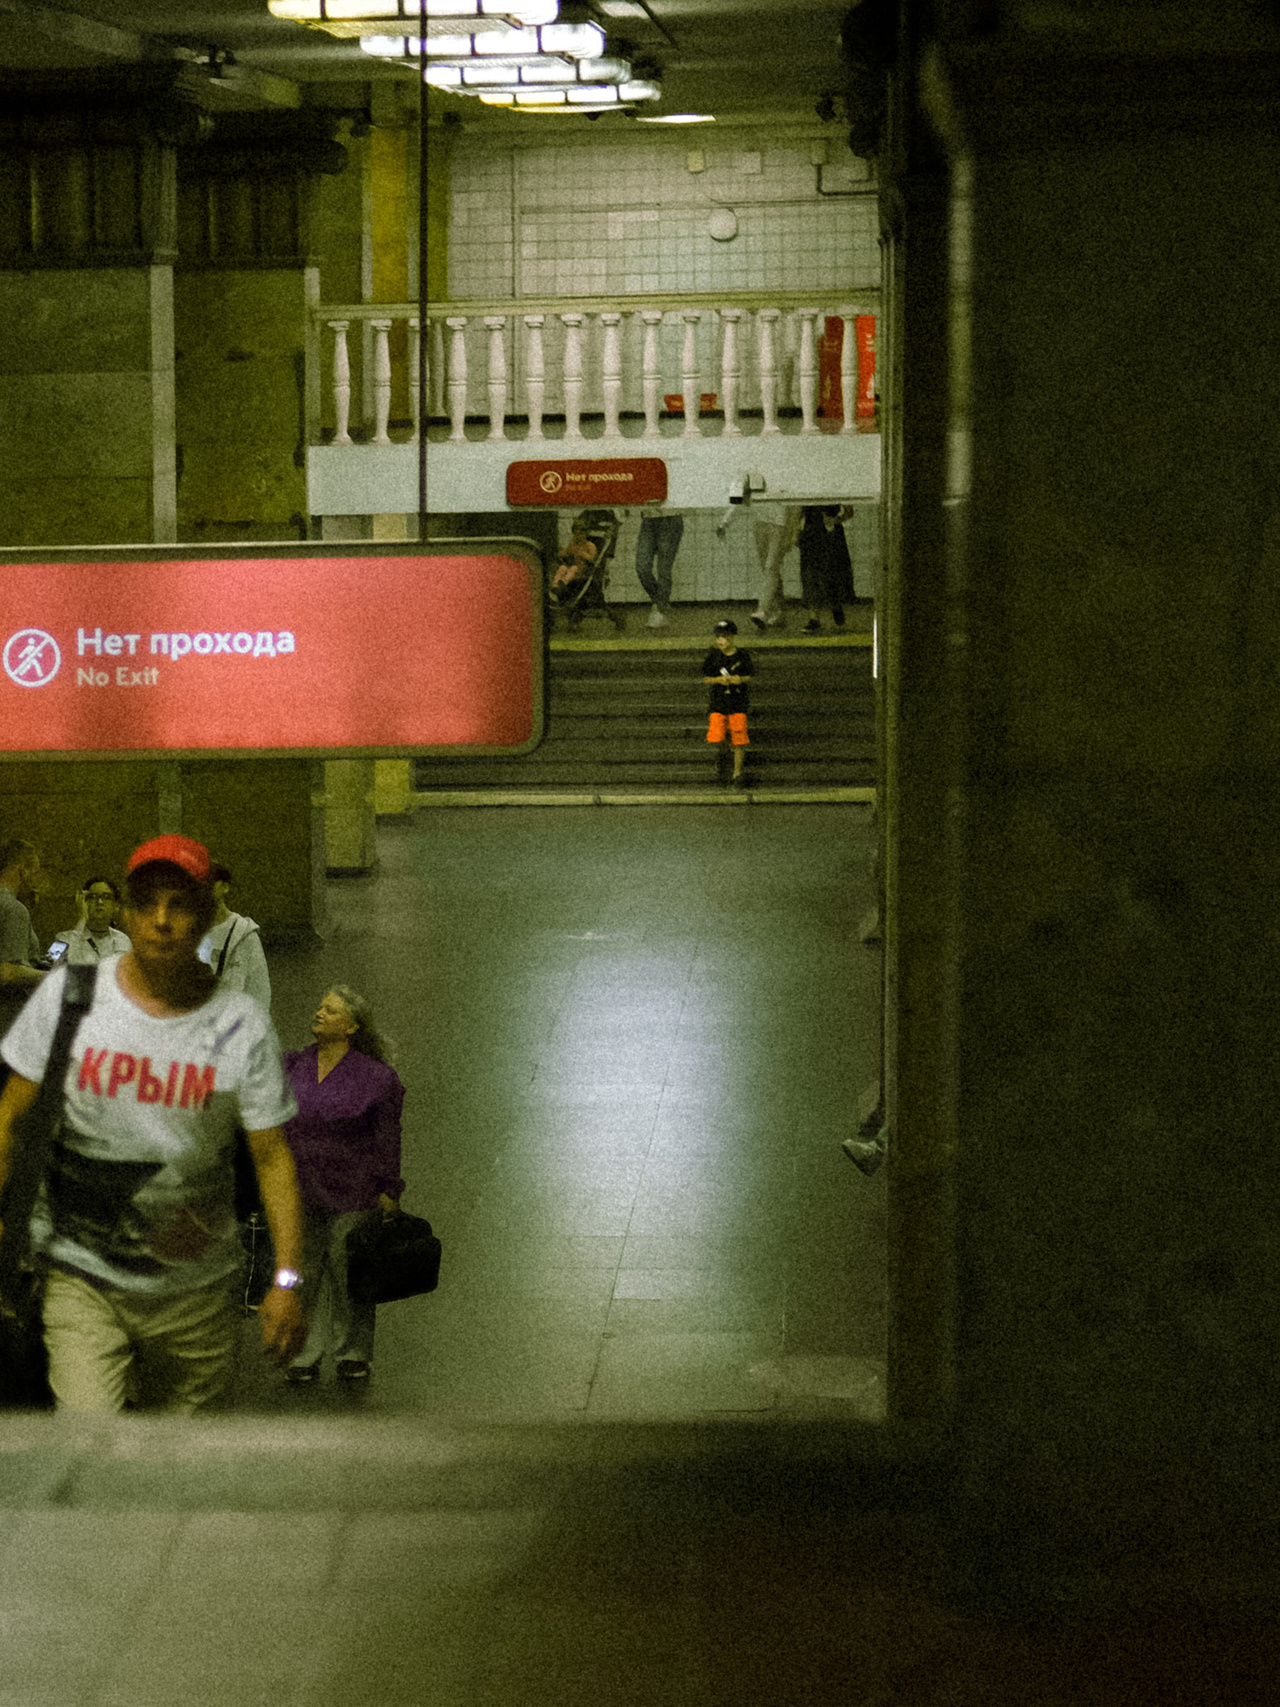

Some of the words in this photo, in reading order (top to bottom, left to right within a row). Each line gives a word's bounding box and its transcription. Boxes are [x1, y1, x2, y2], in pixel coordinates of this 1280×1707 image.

[76, 627, 141, 656] Нет
[150, 630, 295, 661] прохода
[76, 667, 109, 687] No
[116, 666, 160, 686] Exit
[78, 1047, 216, 1109] КРЫМ
